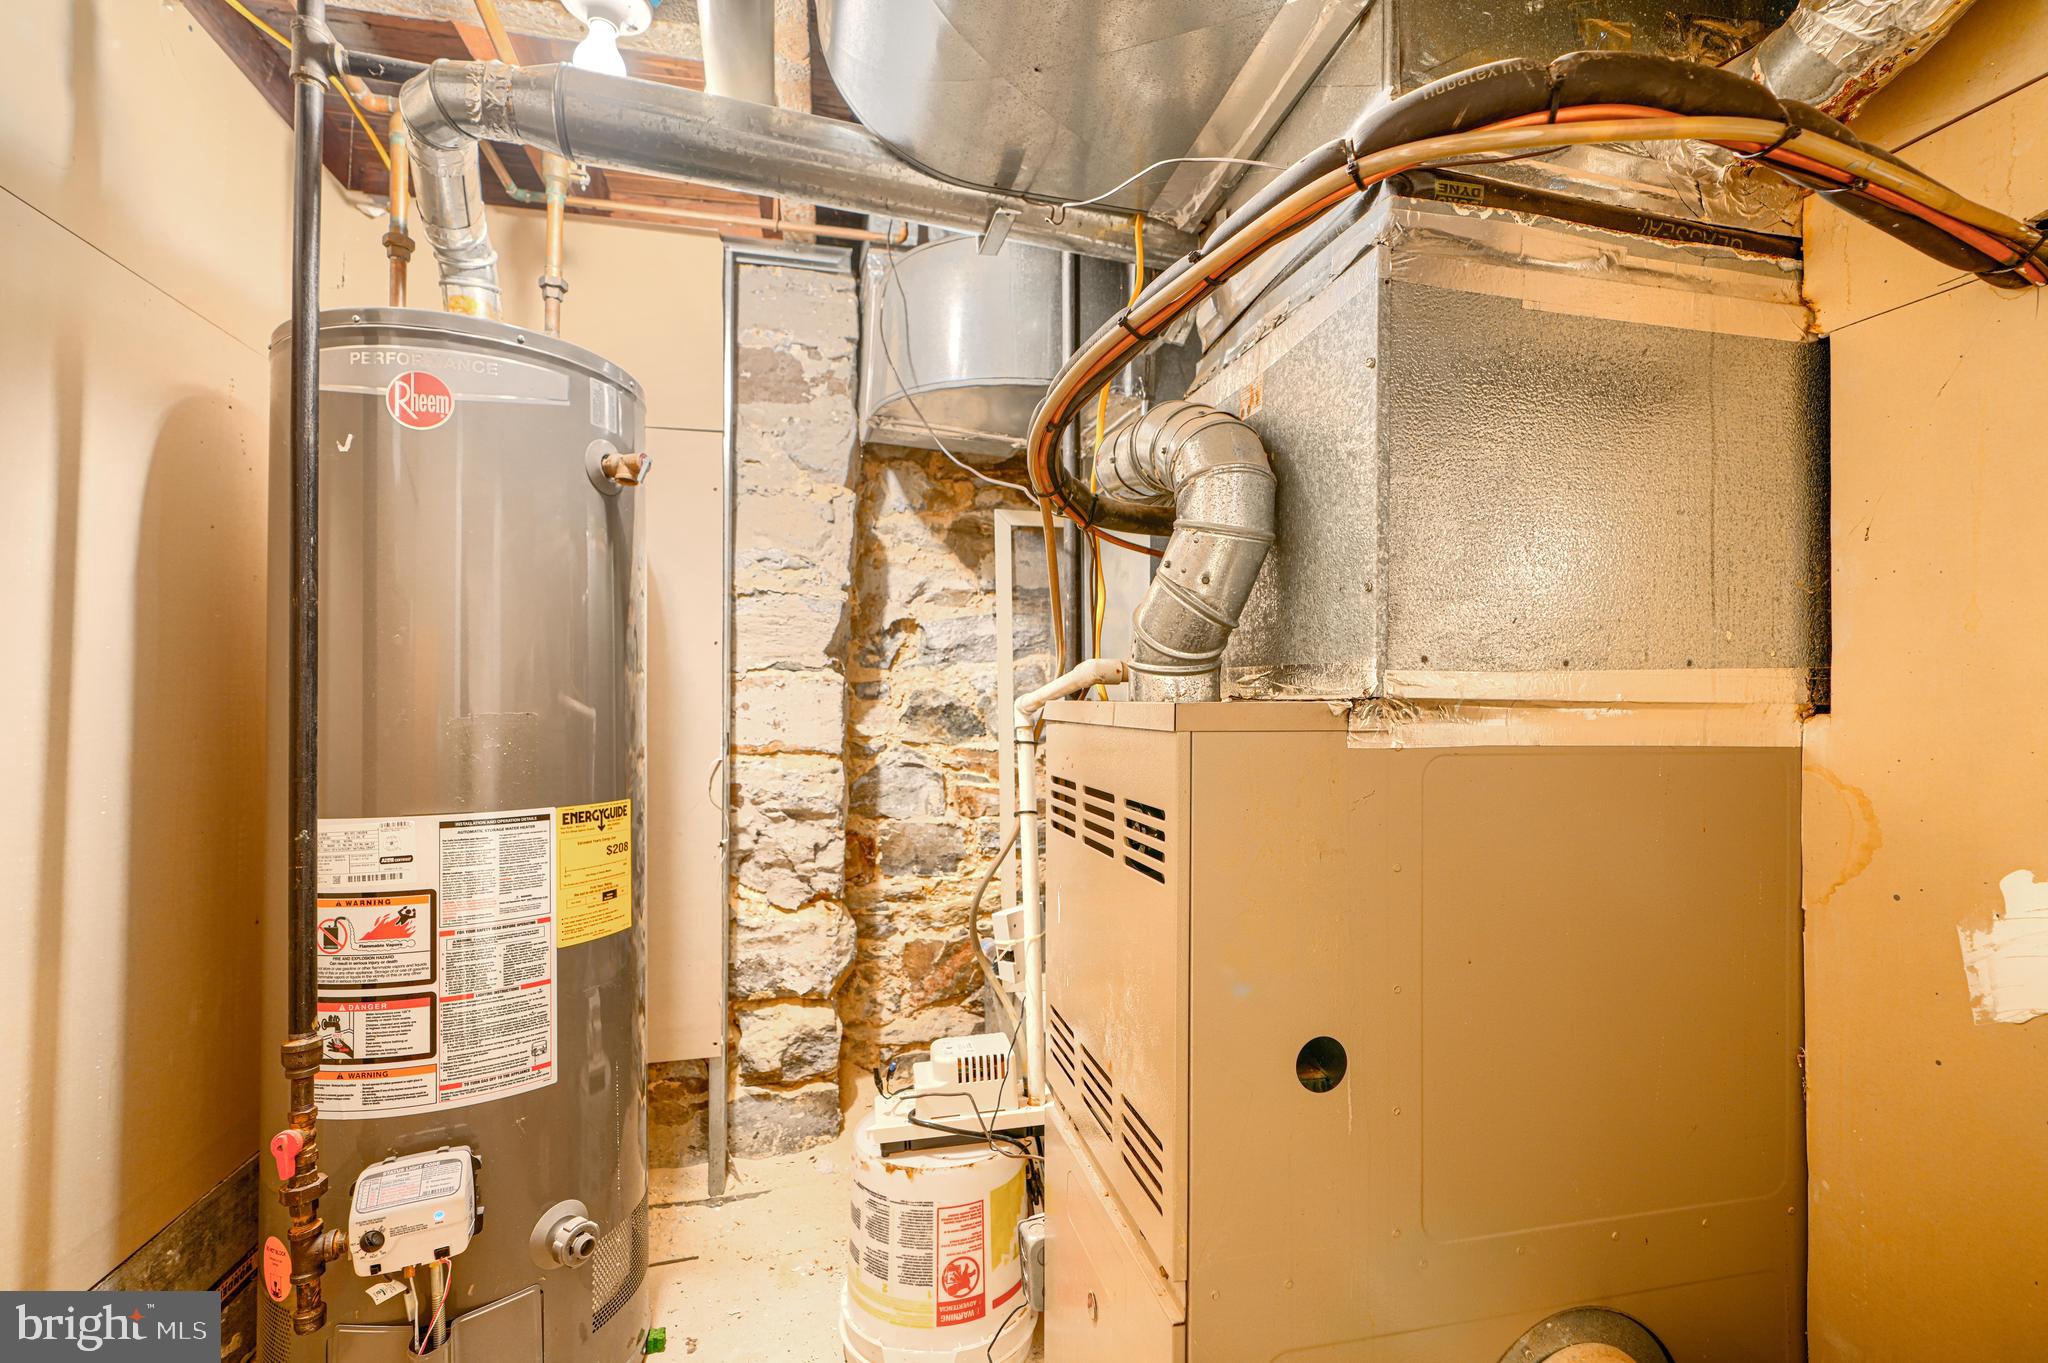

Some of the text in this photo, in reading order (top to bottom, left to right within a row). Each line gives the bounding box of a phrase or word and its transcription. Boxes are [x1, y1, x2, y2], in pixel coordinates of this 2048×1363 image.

[1439, 182, 1481, 198] DYNE
[350, 351, 498, 377] PERFORANCE
[394, 370, 450, 420] Rheem
[346, 898, 391, 906] WARNING
[348, 1003, 387, 1011] DANGER
[348, 1071, 388, 1080] WARNING
[939, 1300, 976, 1312] ADVERTENCIA
[940, 1310, 974, 1323] WARNING
